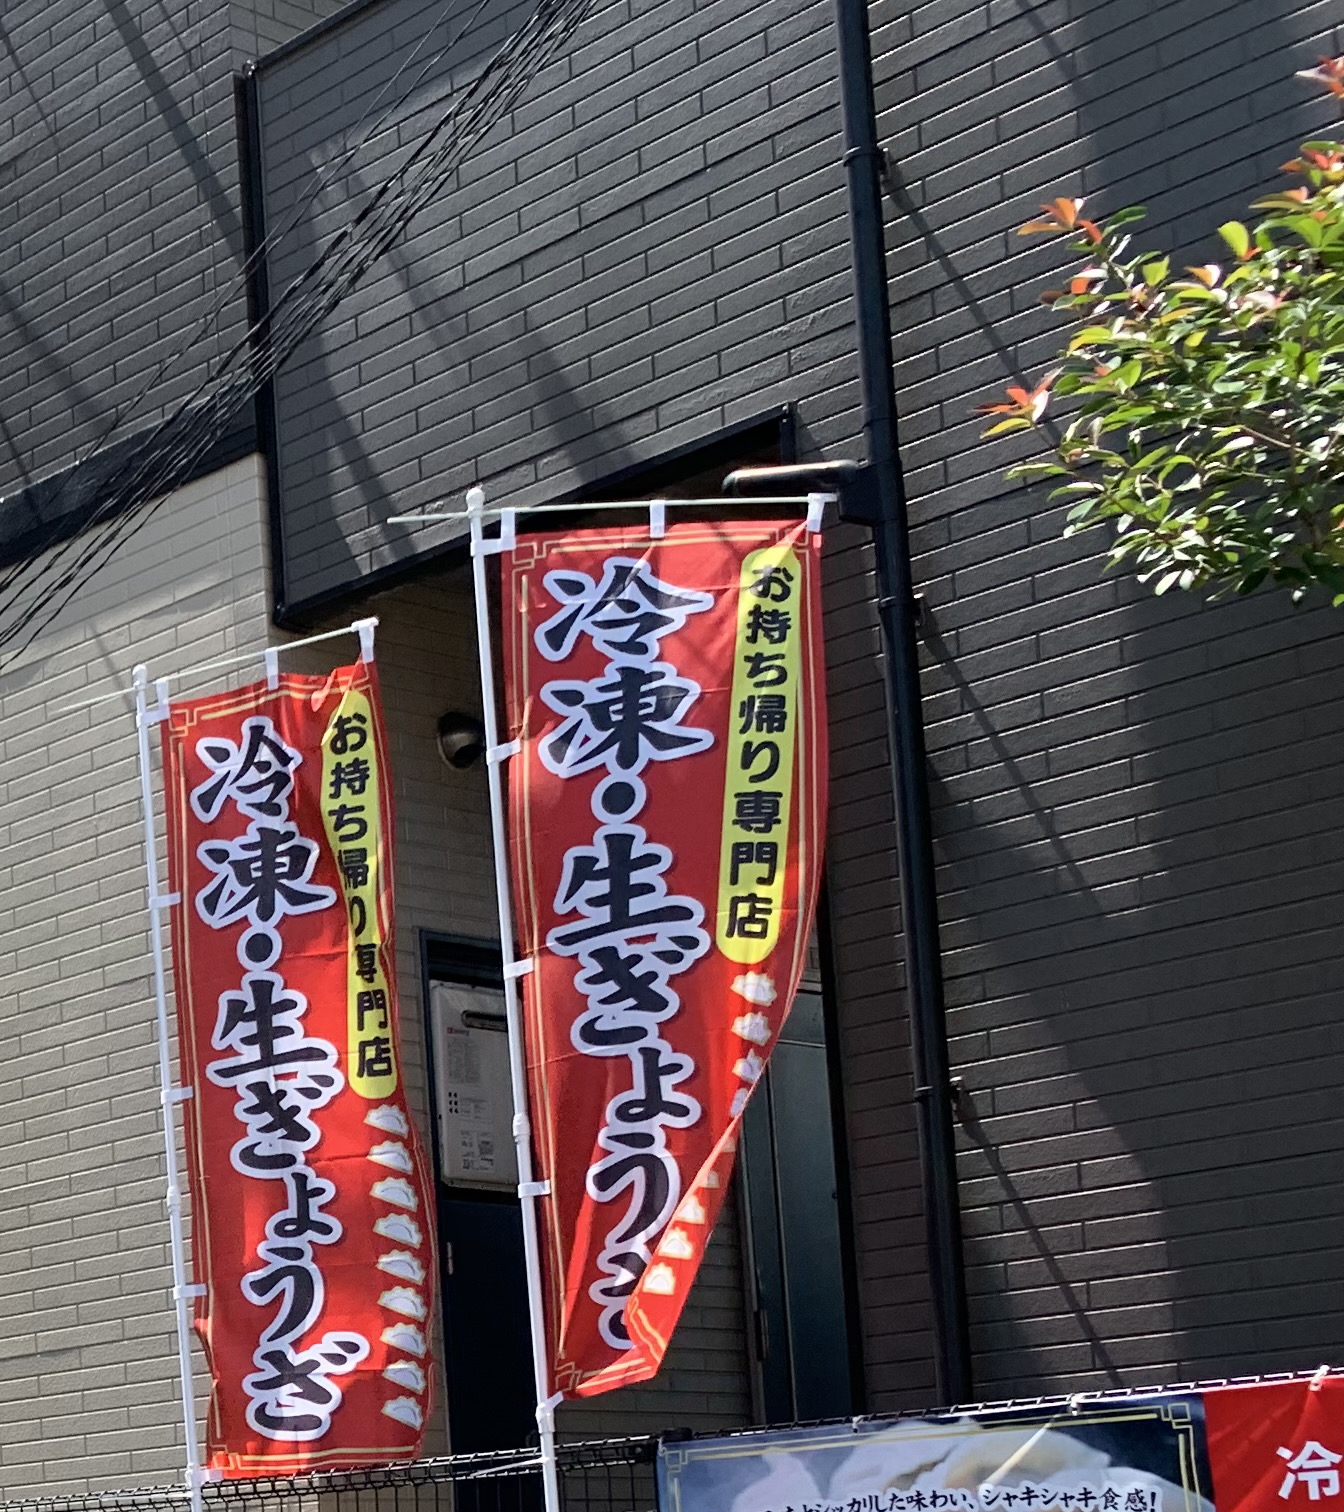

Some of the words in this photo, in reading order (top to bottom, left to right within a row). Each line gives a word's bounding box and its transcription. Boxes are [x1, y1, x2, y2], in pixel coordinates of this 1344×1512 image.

[327, 711, 392, 1079] お持ち帰り専門店
[725, 563, 793, 941] お持ち帰り専門店
[200, 722, 359, 1436] 冷凍・生ぎょうざ
[1276, 1440, 1344, 1501] 冷
